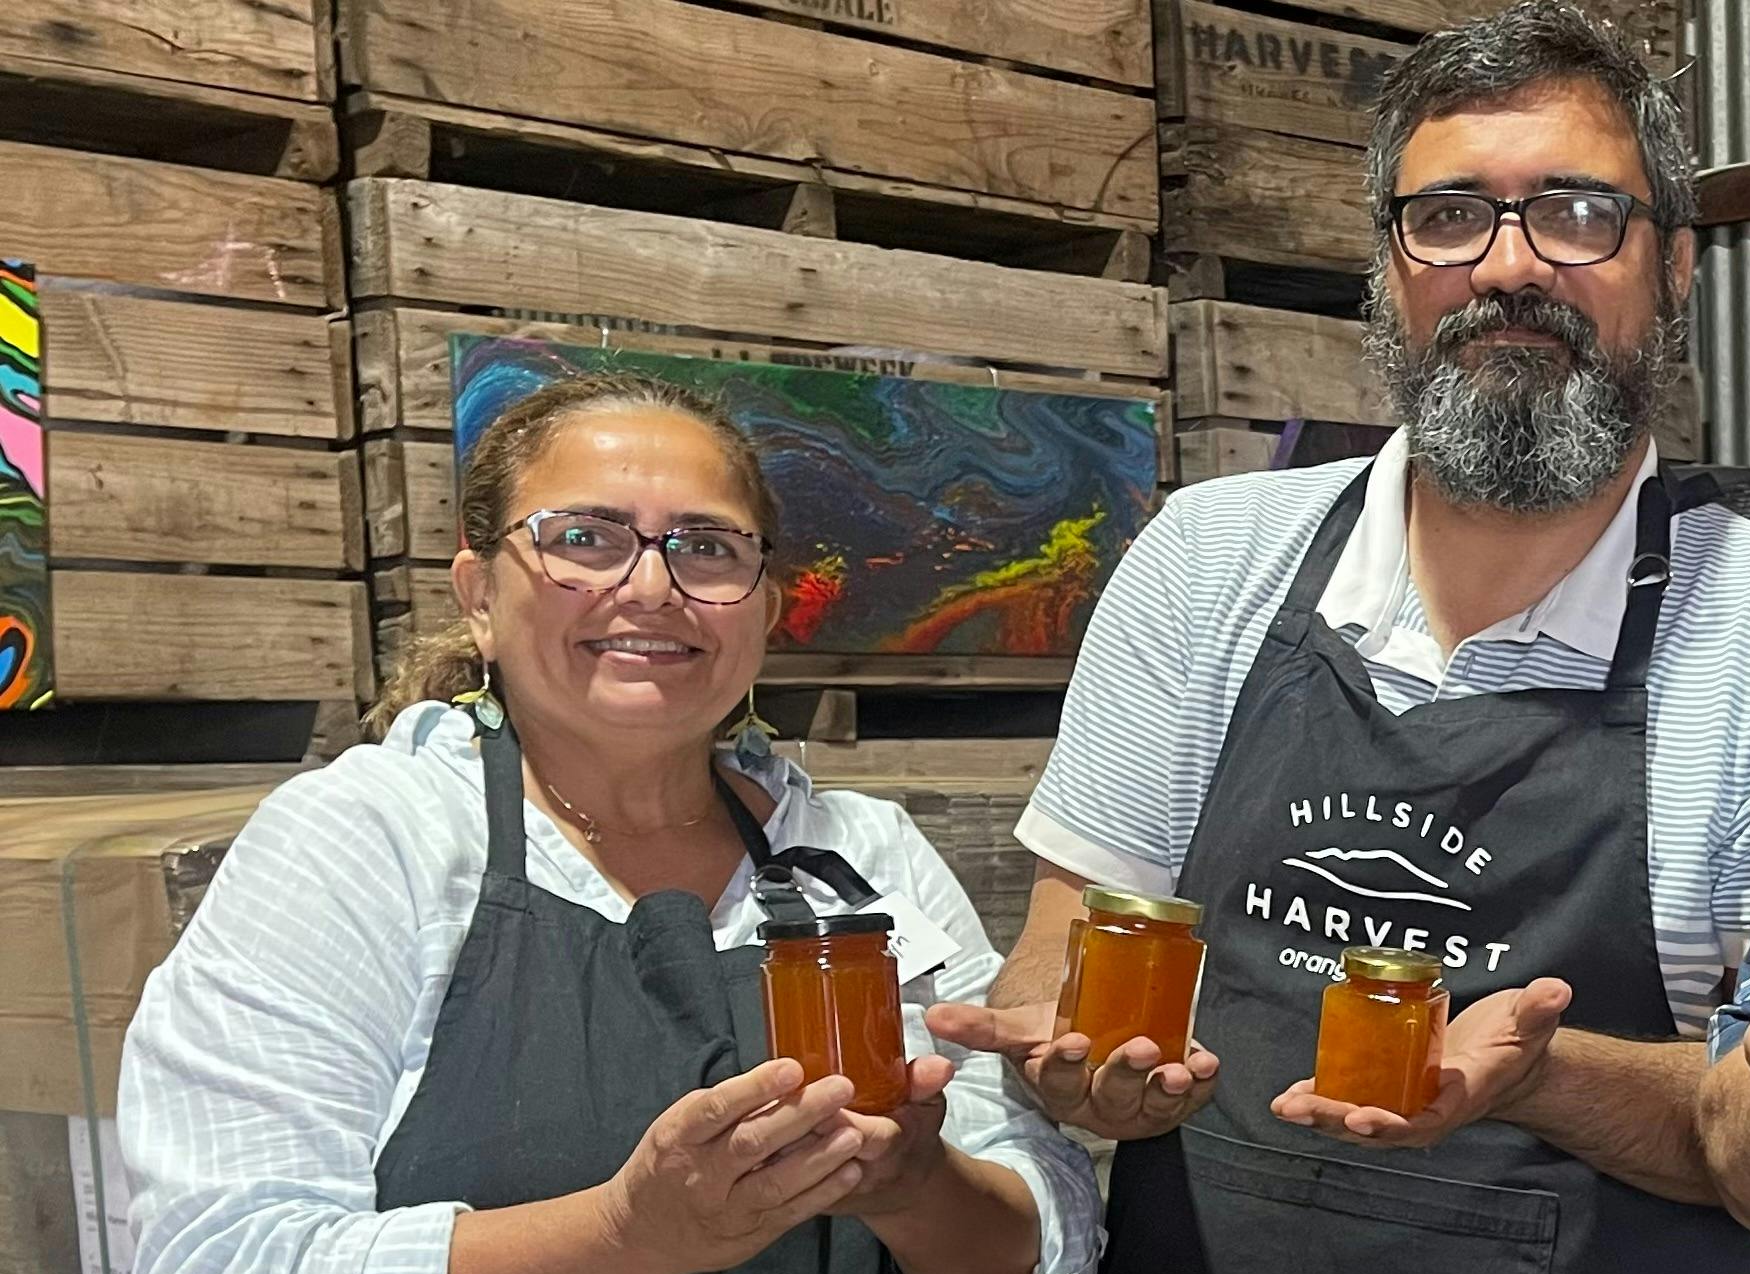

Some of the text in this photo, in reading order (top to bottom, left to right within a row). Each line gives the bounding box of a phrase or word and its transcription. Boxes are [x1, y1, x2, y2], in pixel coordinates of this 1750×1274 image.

[1188, 20, 1397, 86] HARVE
[1289, 792, 1493, 876] HILLSIDE
[1245, 882, 1511, 972] HARVEST
